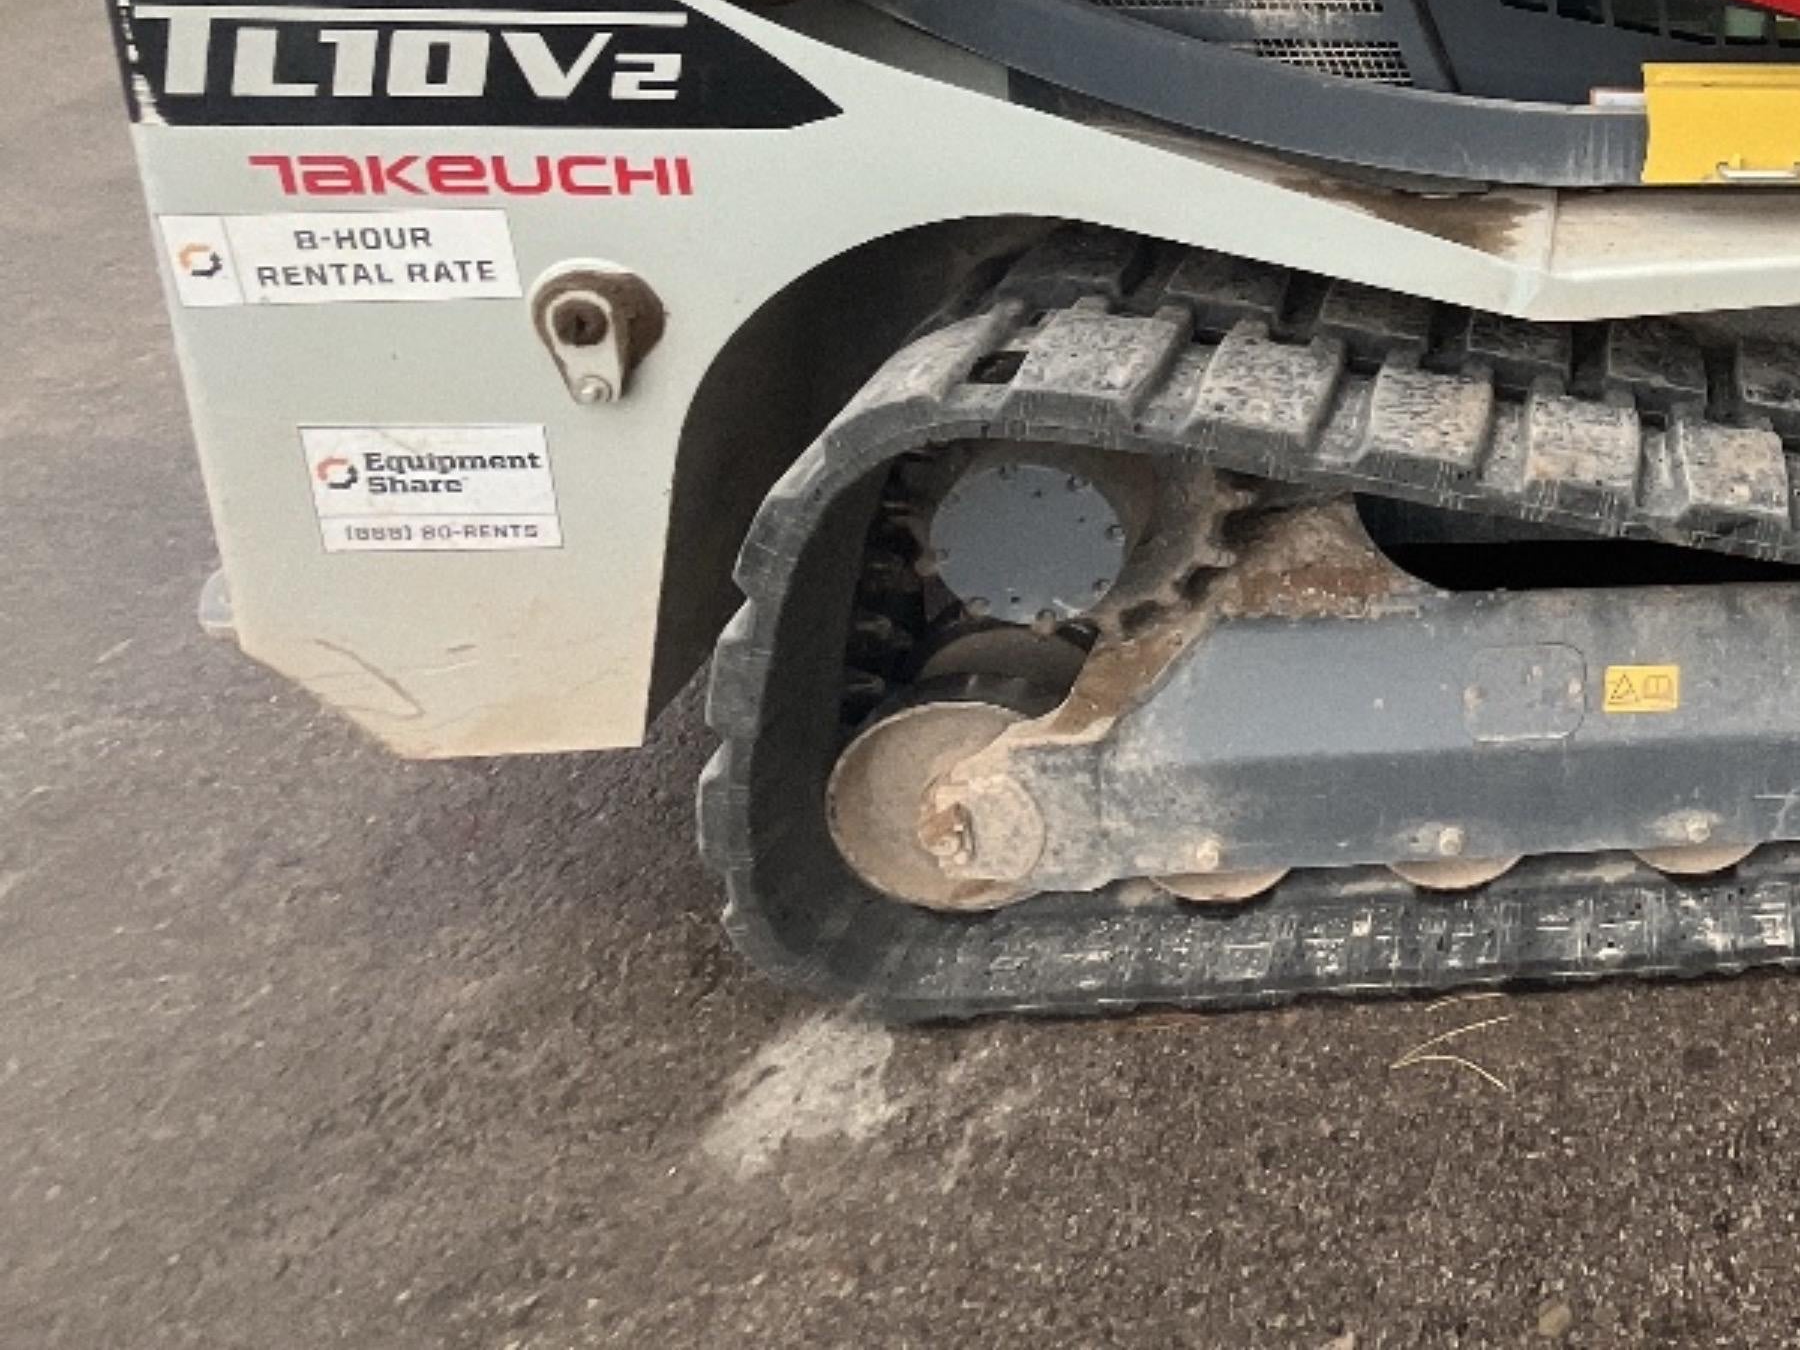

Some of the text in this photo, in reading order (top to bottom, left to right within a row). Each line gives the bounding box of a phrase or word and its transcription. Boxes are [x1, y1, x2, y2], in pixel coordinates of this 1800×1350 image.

[249, 155, 693, 196] TAKEUCHI
[294, 226, 433, 251] 8-HOUR
[257, 259, 498, 288] RENTAL RATE
[363, 451, 542, 475] Equipment
[368, 476, 463, 494] Share
[422, 524, 538, 541] 80-RENTS
